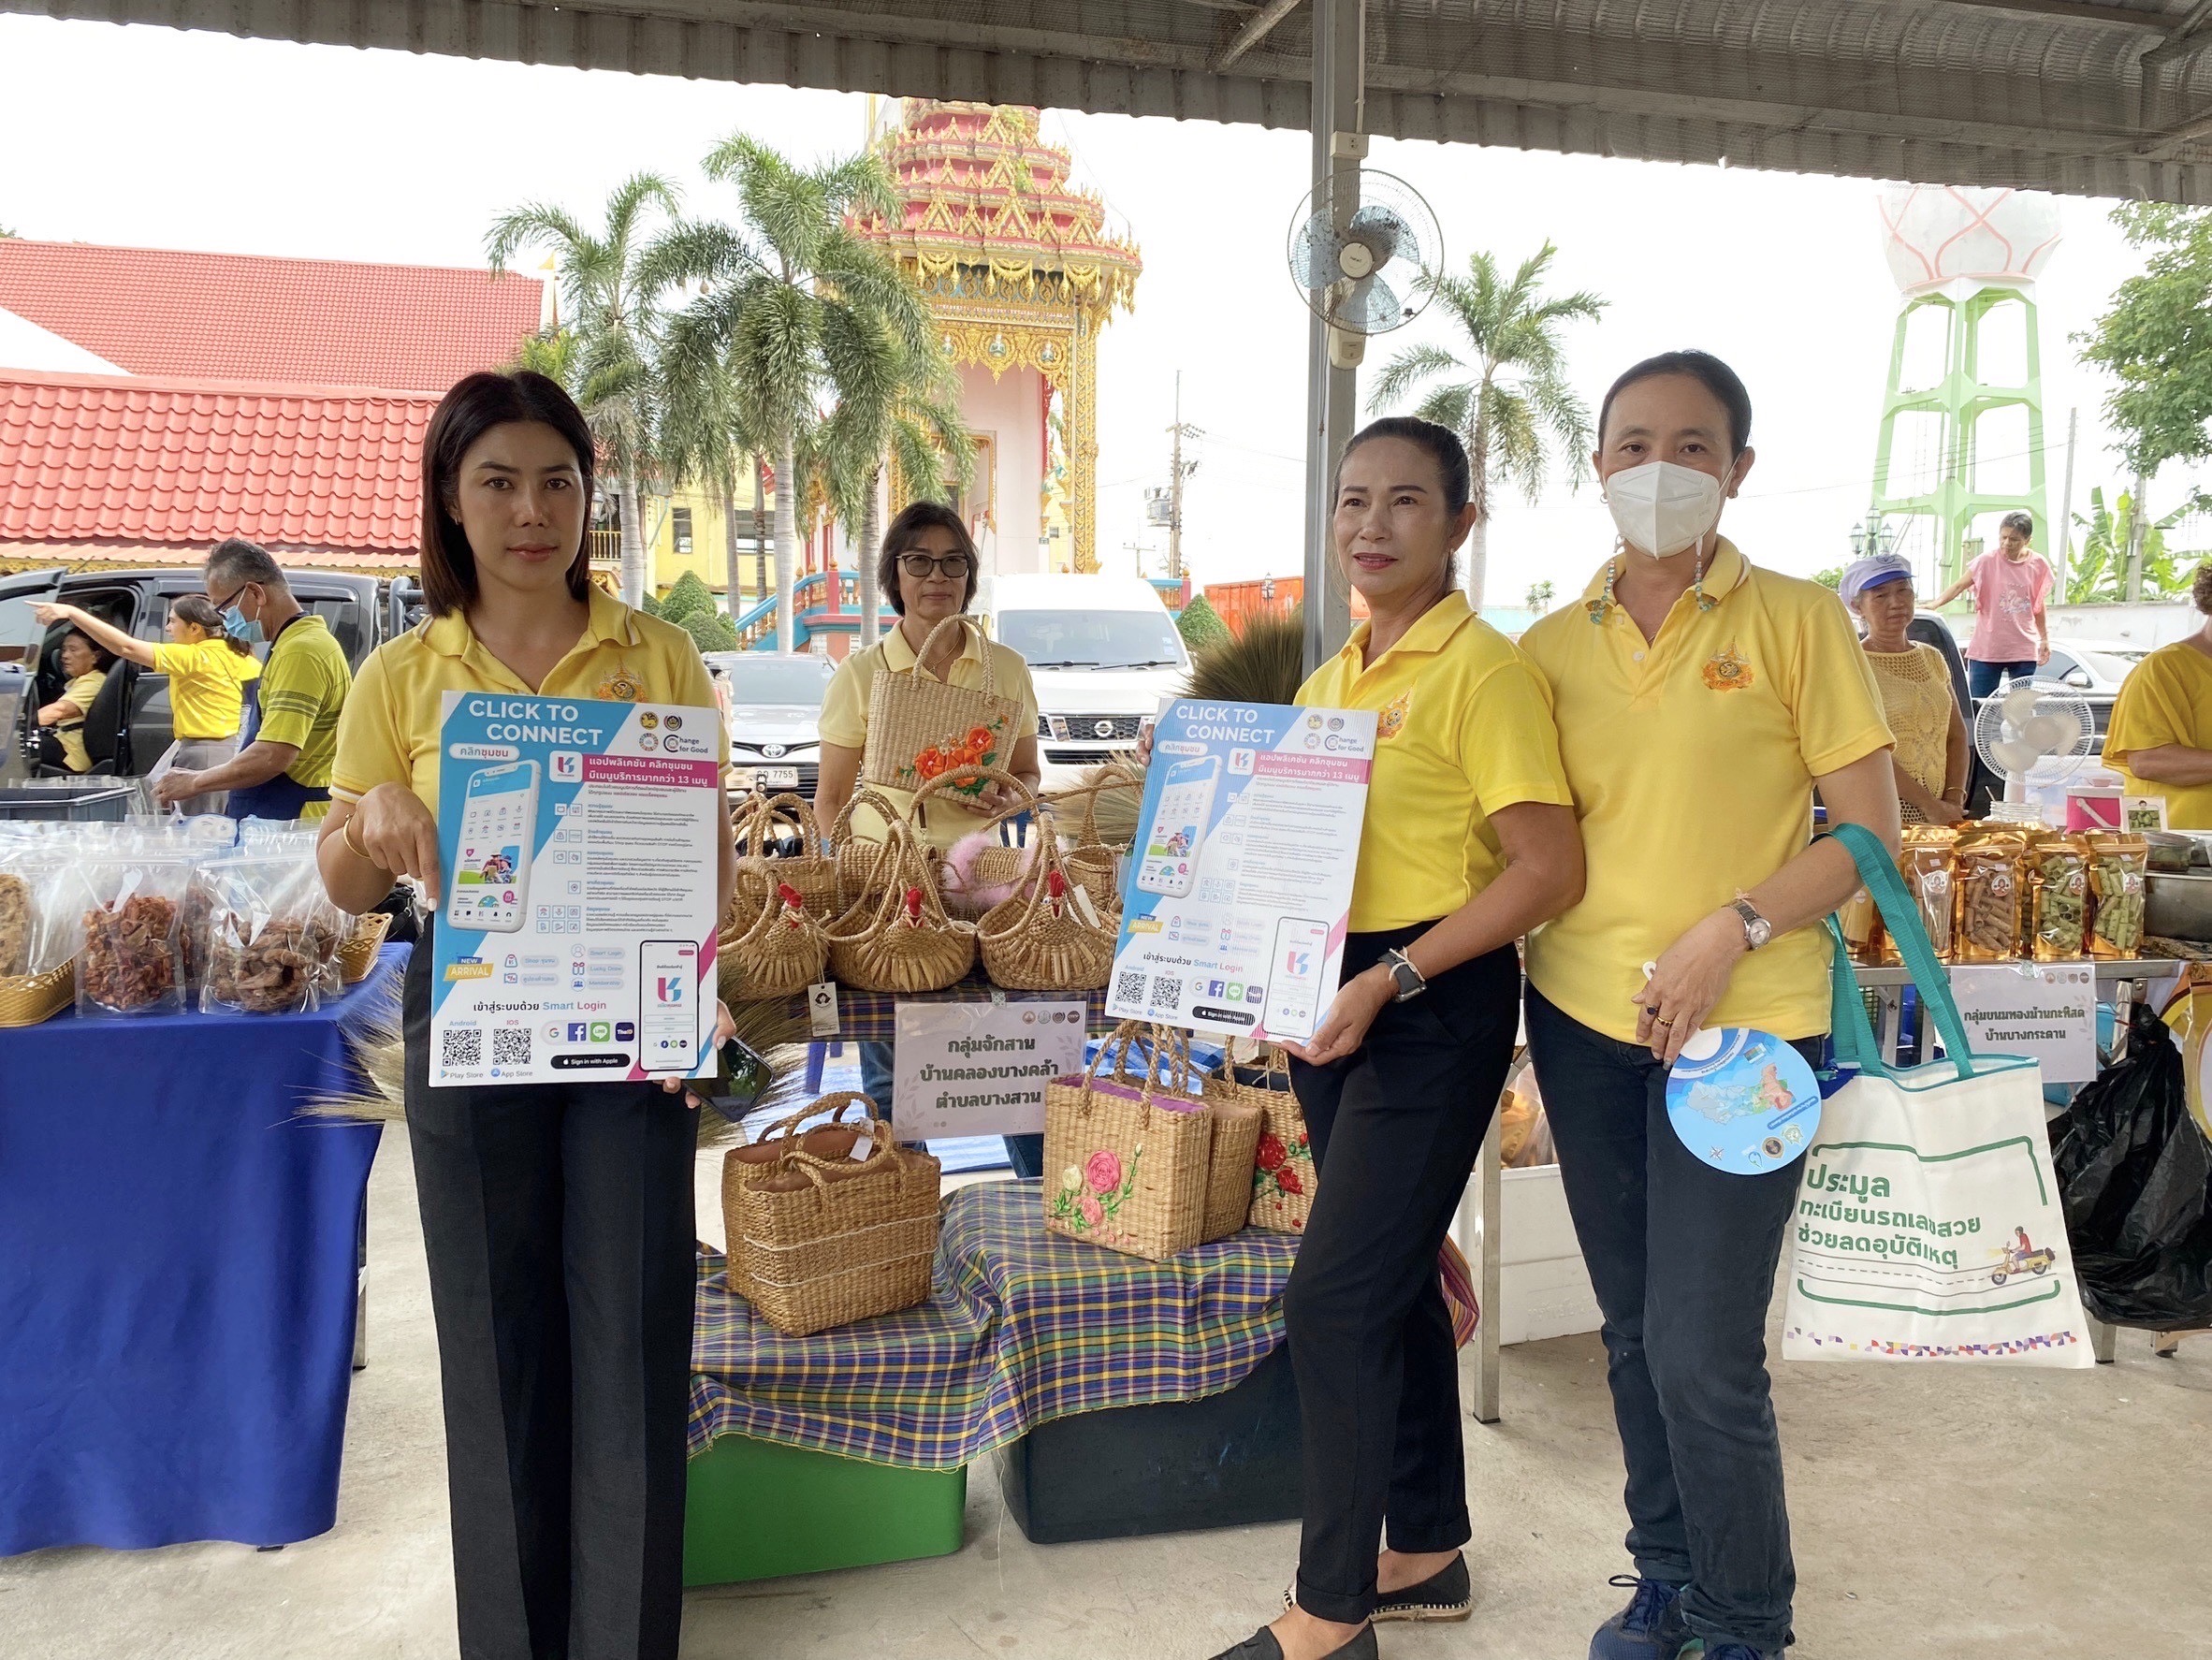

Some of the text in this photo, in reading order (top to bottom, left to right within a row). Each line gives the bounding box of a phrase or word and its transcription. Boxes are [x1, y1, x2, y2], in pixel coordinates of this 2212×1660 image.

[469, 700, 578, 722] CLICK TO
[1176, 705, 1258, 724] CLICK TO
[487, 723, 603, 746] CONNECT
[1186, 724, 1275, 744] CONNECT
[460, 746, 509, 759] คลิกชุมชน
[691, 746, 708, 754] Good
[1165, 743, 1201, 754] คลิกชุมชน
[589, 756, 693, 772] แอปพลิเคชัน คลิกชุมชน
[1259, 752, 1348, 769] แอปพลิเคชัน คลิกชุมชน
[589, 770, 675, 783] มีเมนูบริการมากกว่า
[677, 775, 690, 784] 13
[691, 777, 708, 788] เมนู
[773, 770, 793, 779] 7755
[1258, 764, 1360, 781] มีเมนูบริการมากกว่า 13 เมนู
[1131, 922, 1159, 932] ARRIVAL
[1143, 952, 1244, 973] เข้าสู่ระบบด้วย Smart Login
[450, 967, 489, 976] ARRIVAL
[473, 998, 606, 1013] เข้าสู่ระบบด้วย Smart Login
[1964, 1005, 2085, 1025] กลุ่มขนมทองม้วนกะทิสด
[1986, 1028, 2066, 1041] บ้านบางกระดาน
[449, 1071, 465, 1080] Play
[501, 1070, 517, 1079] App
[920, 1059, 1058, 1082] บ้านคลองบางคล้า
[936, 1091, 1041, 1109] ตำบลบางสวน
[1807, 1163, 1890, 1203] ประมูล
[1799, 1200, 1981, 1238] ทะเบียนรถเลขสวย
[1798, 1223, 1958, 1270] ช่วยลดอุบัติเหตุ
